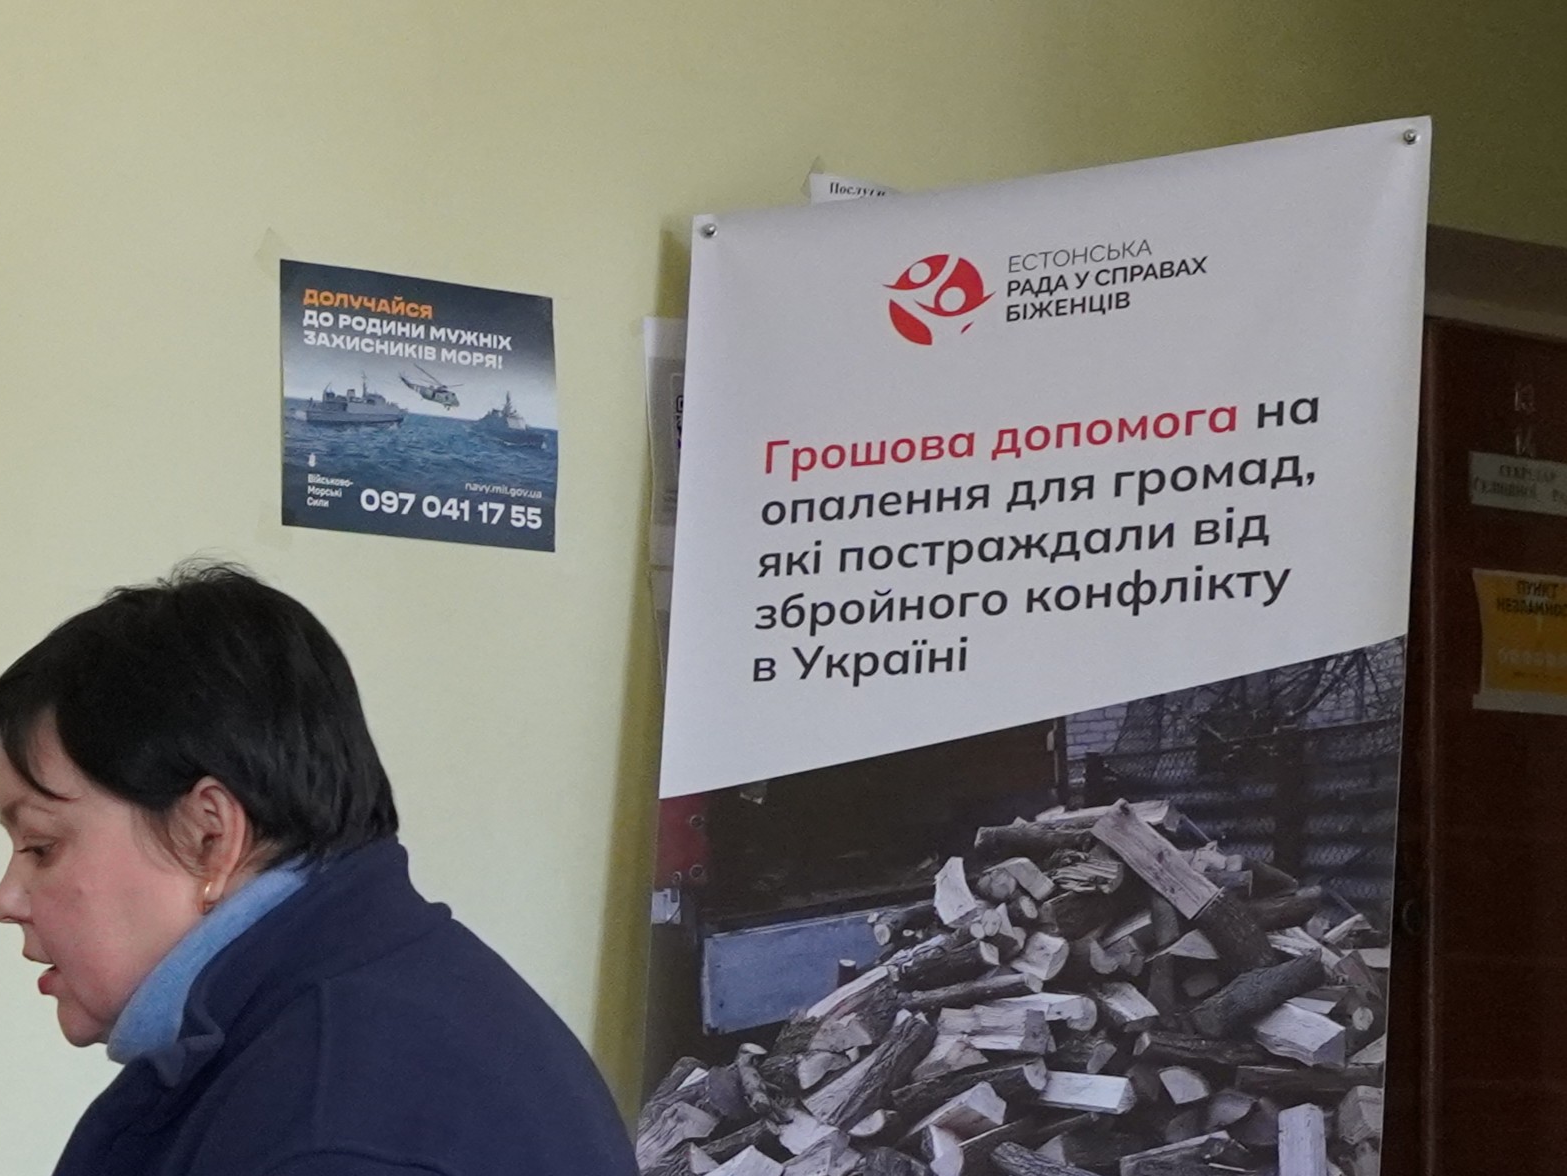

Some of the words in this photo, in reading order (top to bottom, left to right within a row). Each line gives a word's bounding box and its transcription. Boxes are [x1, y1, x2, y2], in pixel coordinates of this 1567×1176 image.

[1008, 239, 1152, 273] ЕСТОНСЬКА
[1006, 274, 1068, 298] РАДА
[1074, 271, 1090, 289] У
[1094, 256, 1208, 287] СПРАВАХ
[302, 288, 433, 320] ДОЛУЧАЙСЯ
[1006, 292, 1130, 322] БІЖЕНЦІВ
[302, 309, 334, 328] ДО
[338, 313, 425, 339] РОДИНИ
[429, 326, 513, 351] МУЖНІХ
[303, 330, 436, 361] ЗАХИСНИКІВ
[440, 348, 503, 369] МОРЯ!
[765, 432, 975, 482] Грошова
[991, 406, 1237, 460] допомога
[1257, 397, 1319, 428] на
[306, 497, 329, 507] Сили
[307, 485, 342, 498] Морські
[360, 488, 416, 515] 097
[422, 495, 470, 521] 041
[477, 501, 505, 524] 17
[510, 506, 542, 529] 55
[465, 482, 543, 499] navy.mil.gov.ua
[761, 484, 990, 525] опалення
[1007, 475, 1094, 512] для
[1114, 455, 1315, 505] громад,
[758, 540, 822, 578] які
[839, 521, 1175, 575] постраждали
[1194, 507, 1269, 548] від
[755, 588, 1008, 637] збройного
[1026, 565, 1292, 616] конфлікту
[753, 657, 777, 682] в
[792, 637, 968, 687] Україні
